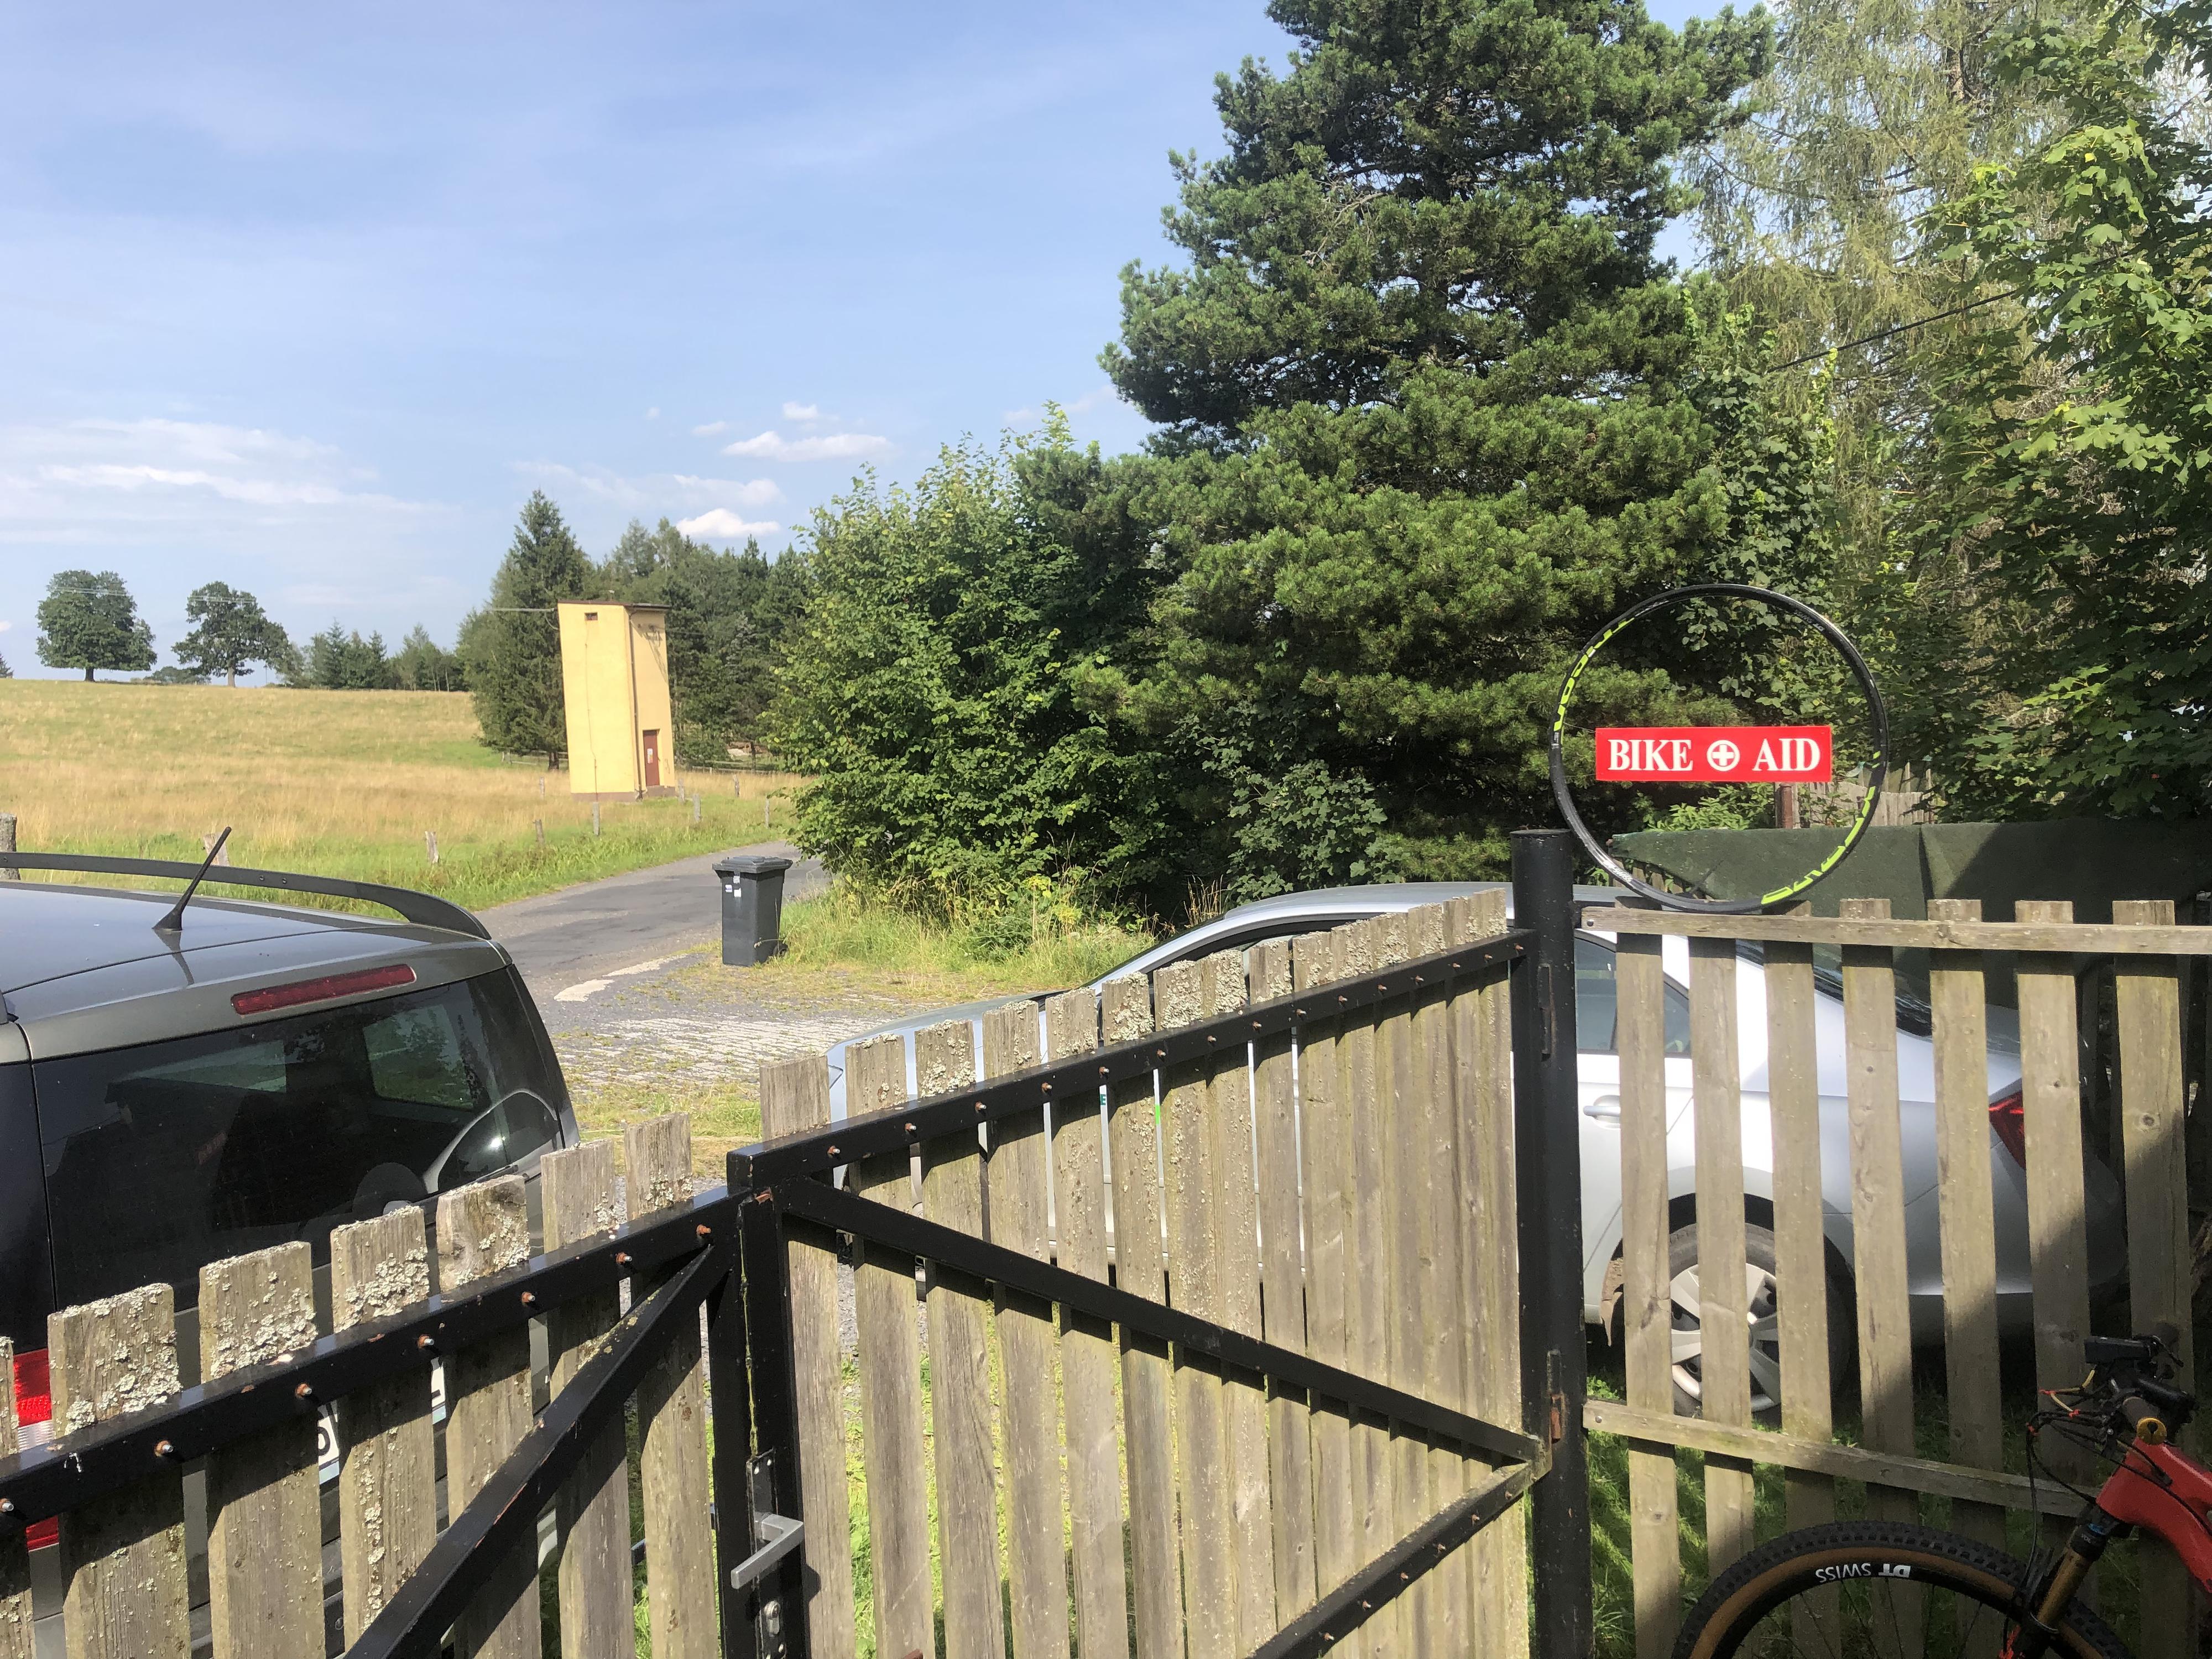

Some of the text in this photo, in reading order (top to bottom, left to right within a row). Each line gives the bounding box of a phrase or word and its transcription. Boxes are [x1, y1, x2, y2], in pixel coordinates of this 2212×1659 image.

[1607, 738, 1821, 771] BIKE AID
[1815, 1563, 1911, 1583] DT SWISS
